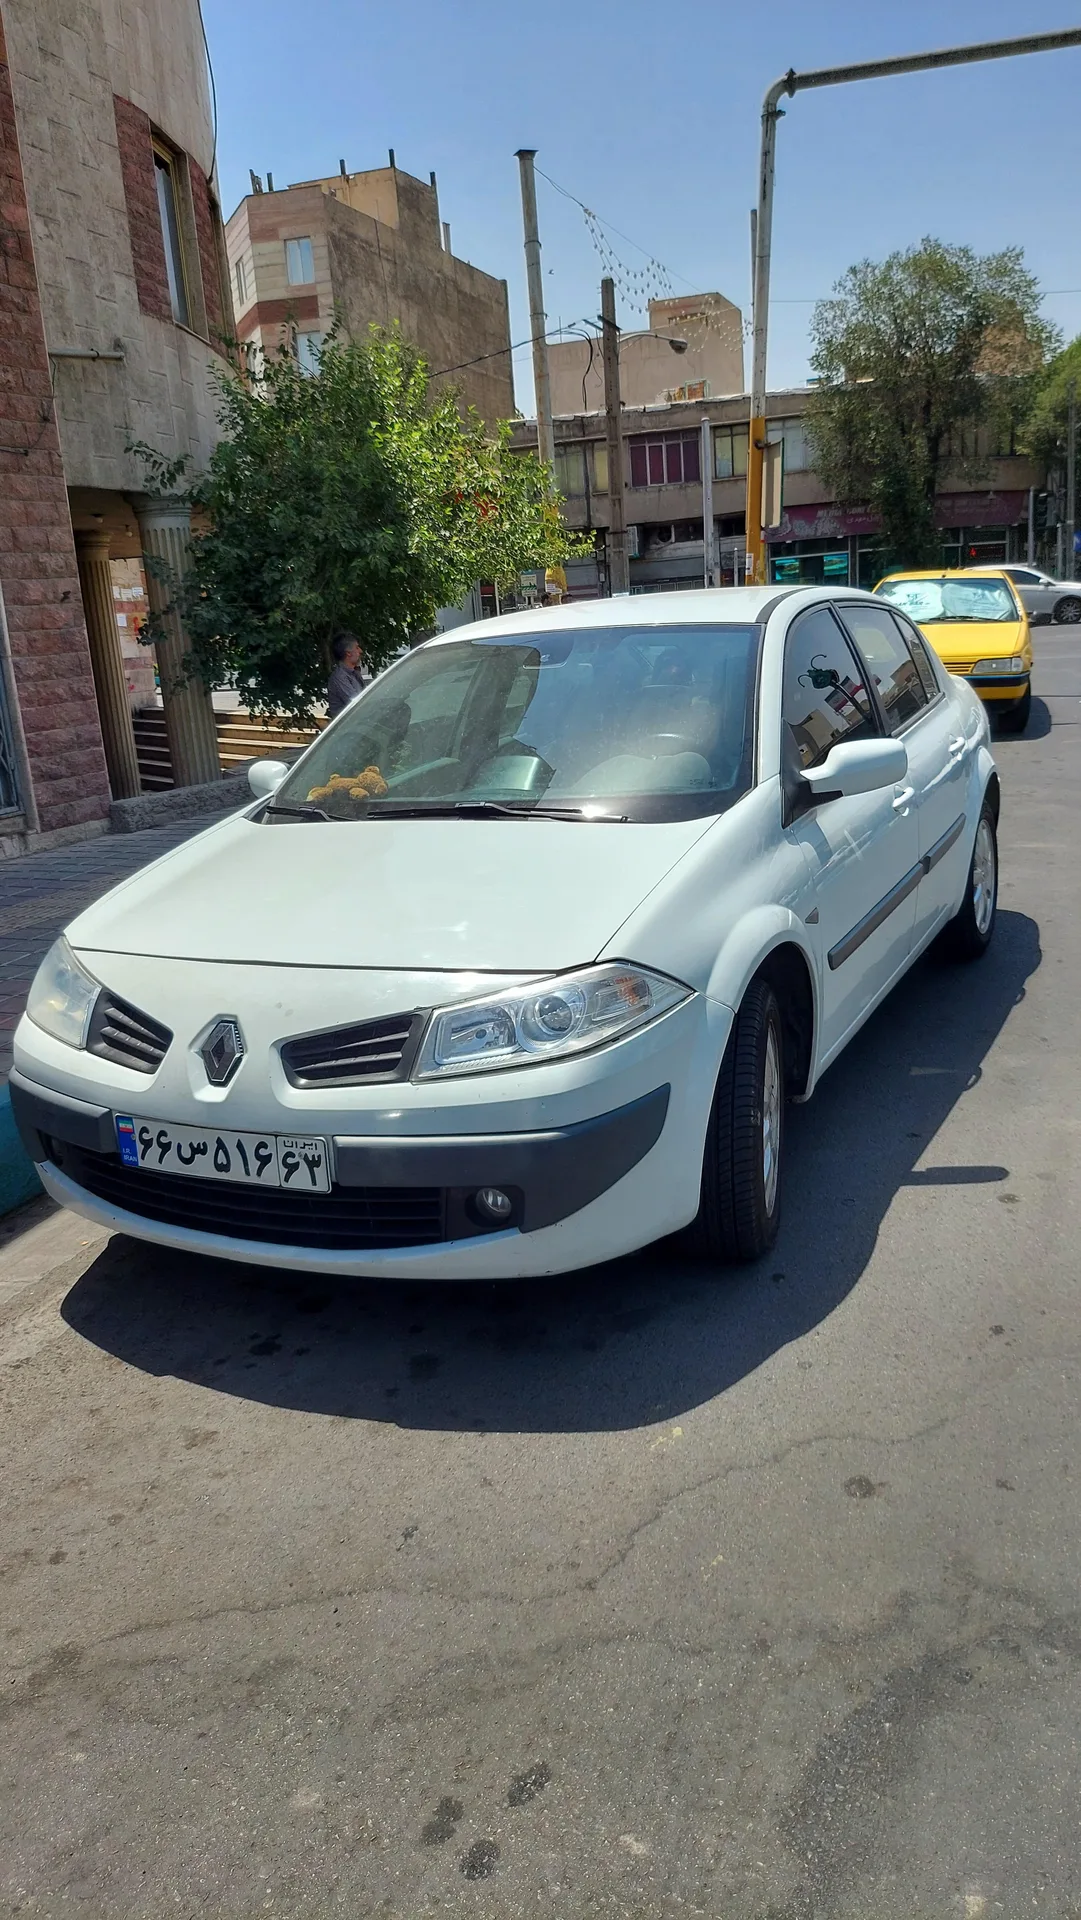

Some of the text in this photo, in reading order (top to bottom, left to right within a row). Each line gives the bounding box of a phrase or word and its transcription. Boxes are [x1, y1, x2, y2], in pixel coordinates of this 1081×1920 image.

[283, 1140, 318, 1151] ایران
[123, 1154, 138, 1163] IRAN
[281, 1150, 322, 1187] ۶۳
